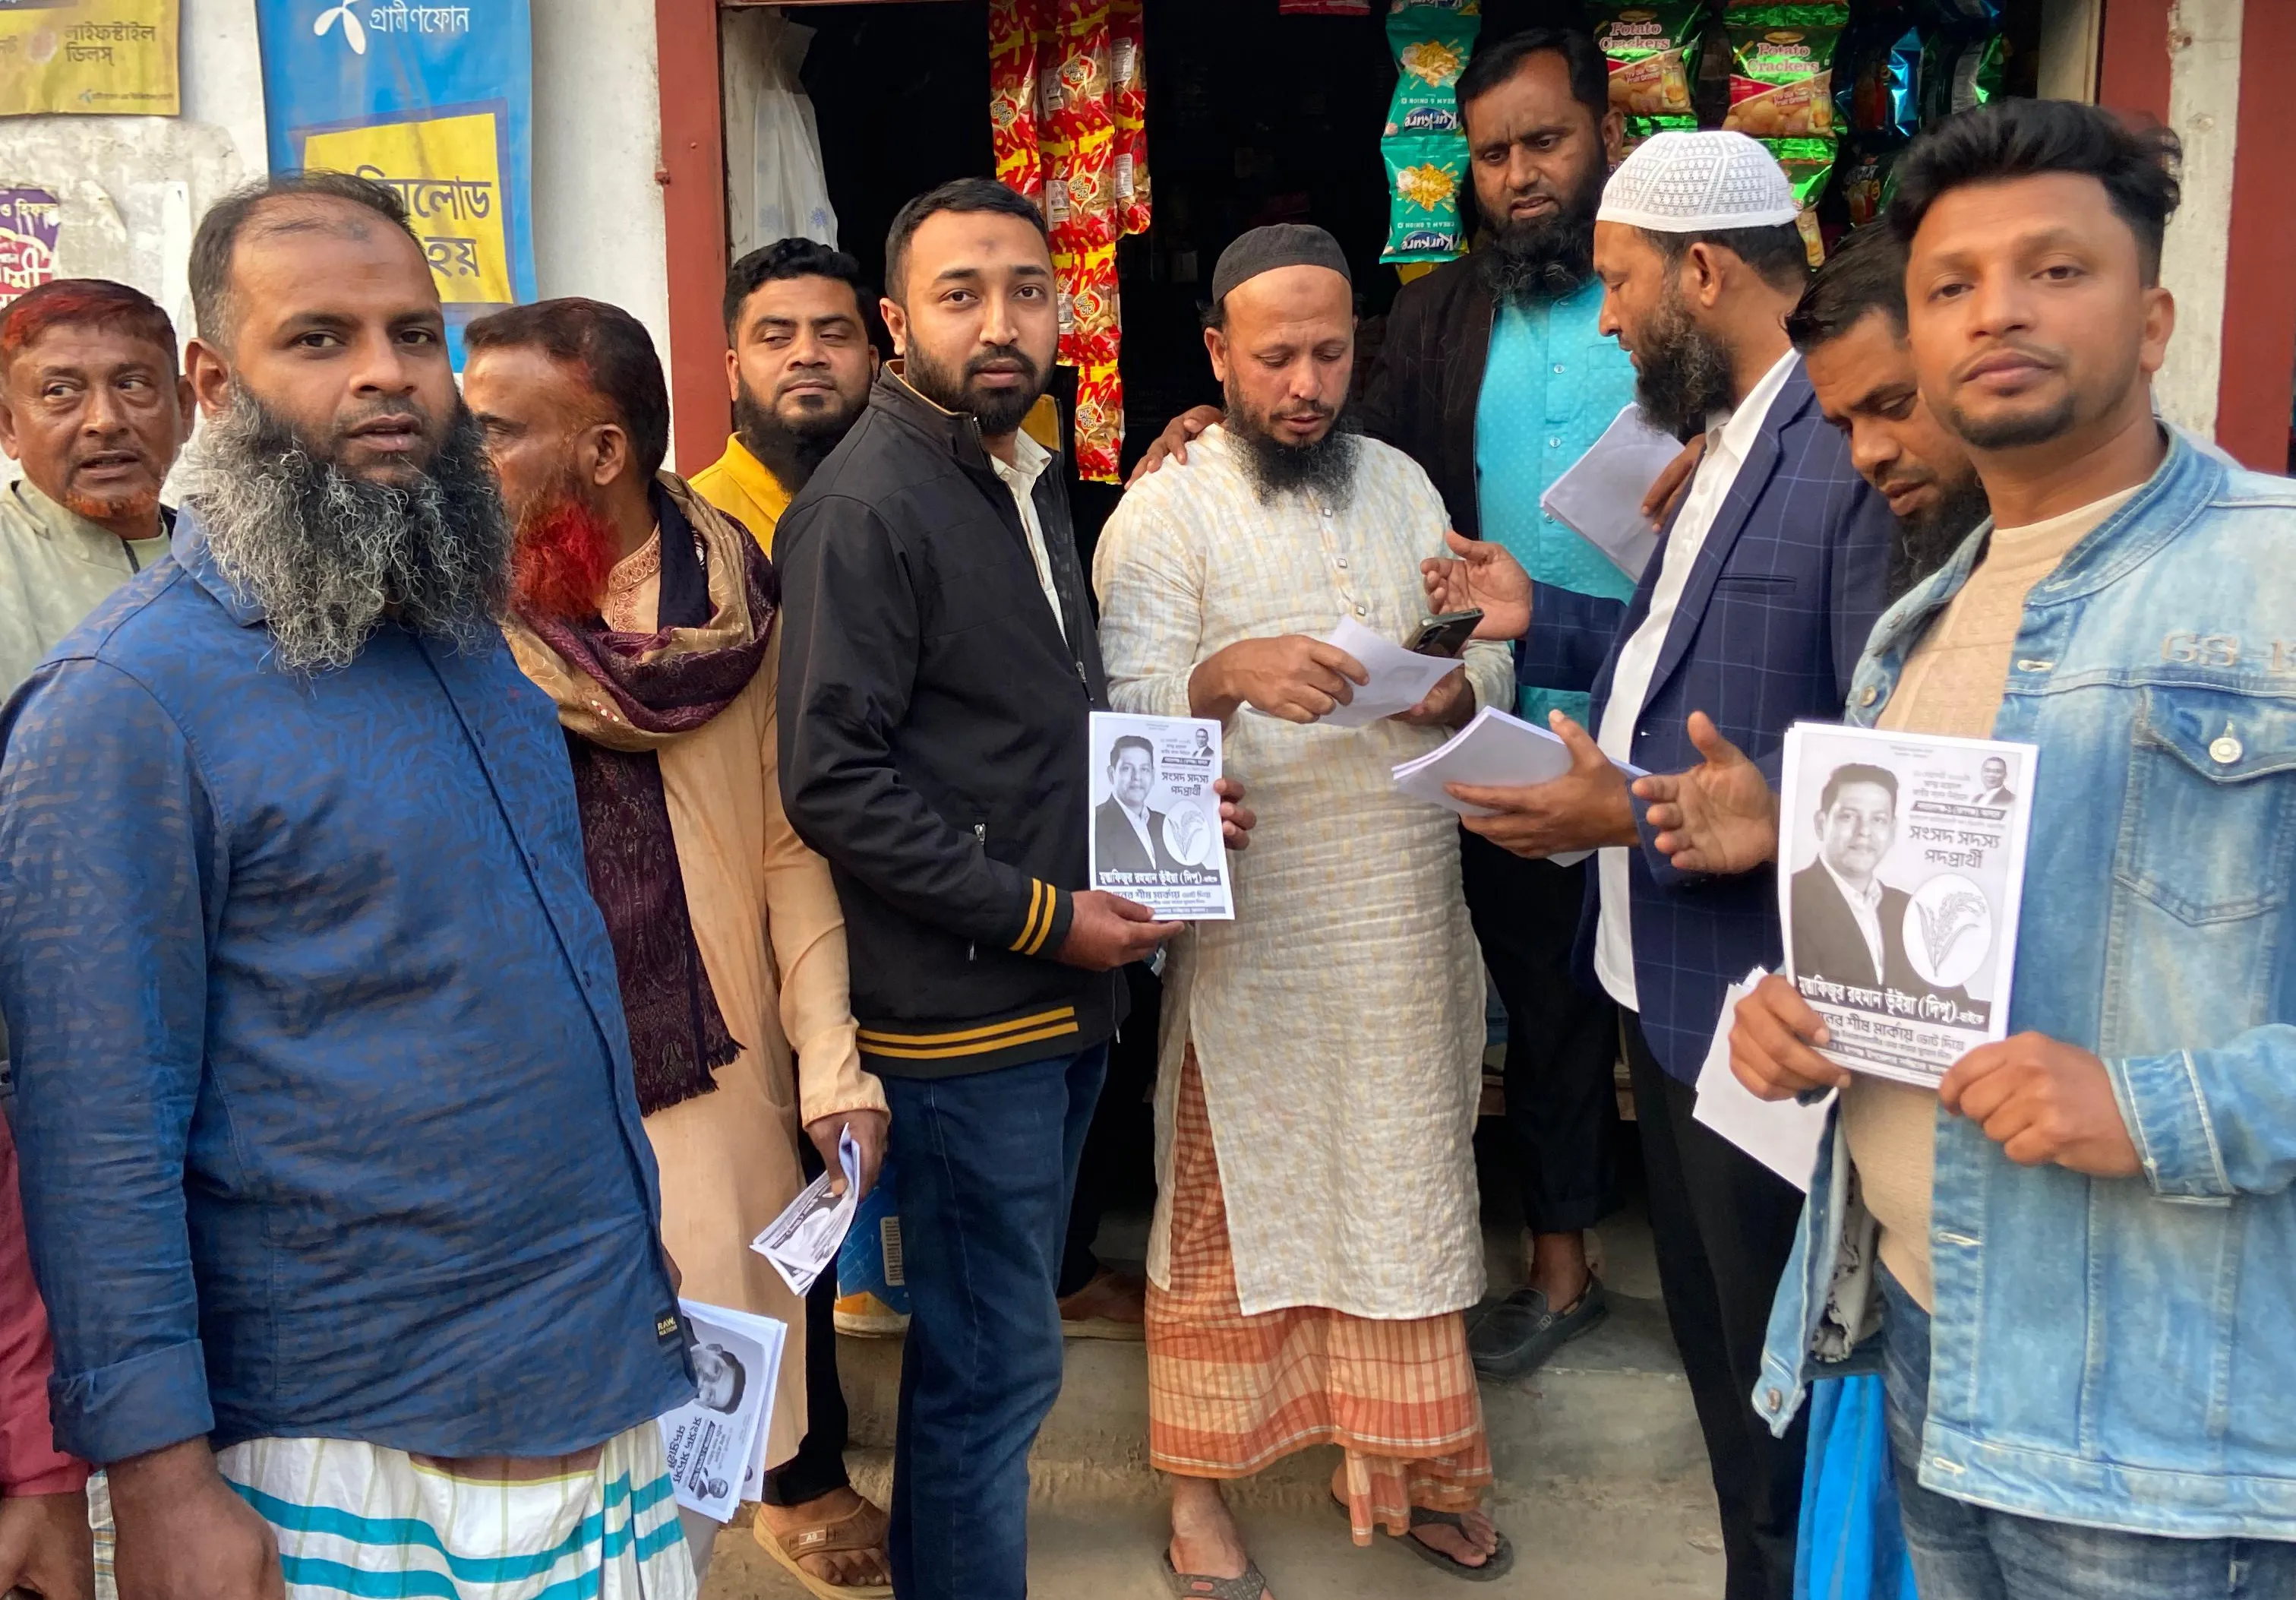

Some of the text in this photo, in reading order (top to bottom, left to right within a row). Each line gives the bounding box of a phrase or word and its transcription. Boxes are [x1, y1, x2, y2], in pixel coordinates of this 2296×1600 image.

[369, 0, 470, 33] গ্রামীণফোন
[1609, 21, 1662, 36] Potato
[1600, 36, 1670, 51] Crackers
[1757, 43, 1811, 57] Potato
[1747, 59, 1820, 73] Crackers
[1404, 109, 1458, 130] Kurkure
[1401, 232, 1454, 251] Kurkure
[424, 236, 481, 278] হয়
[1161, 772, 1210, 783] সংসদ সদস্য
[1171, 784, 1202, 796] পদপ্রার্থী
[1909, 825, 2001, 849] সংসদ সদস্য
[1924, 848, 1984, 868] পদপ্রার্থী
[683, 1417, 703, 1451] সংসদ
[673, 1452, 690, 1485] সদস্য
